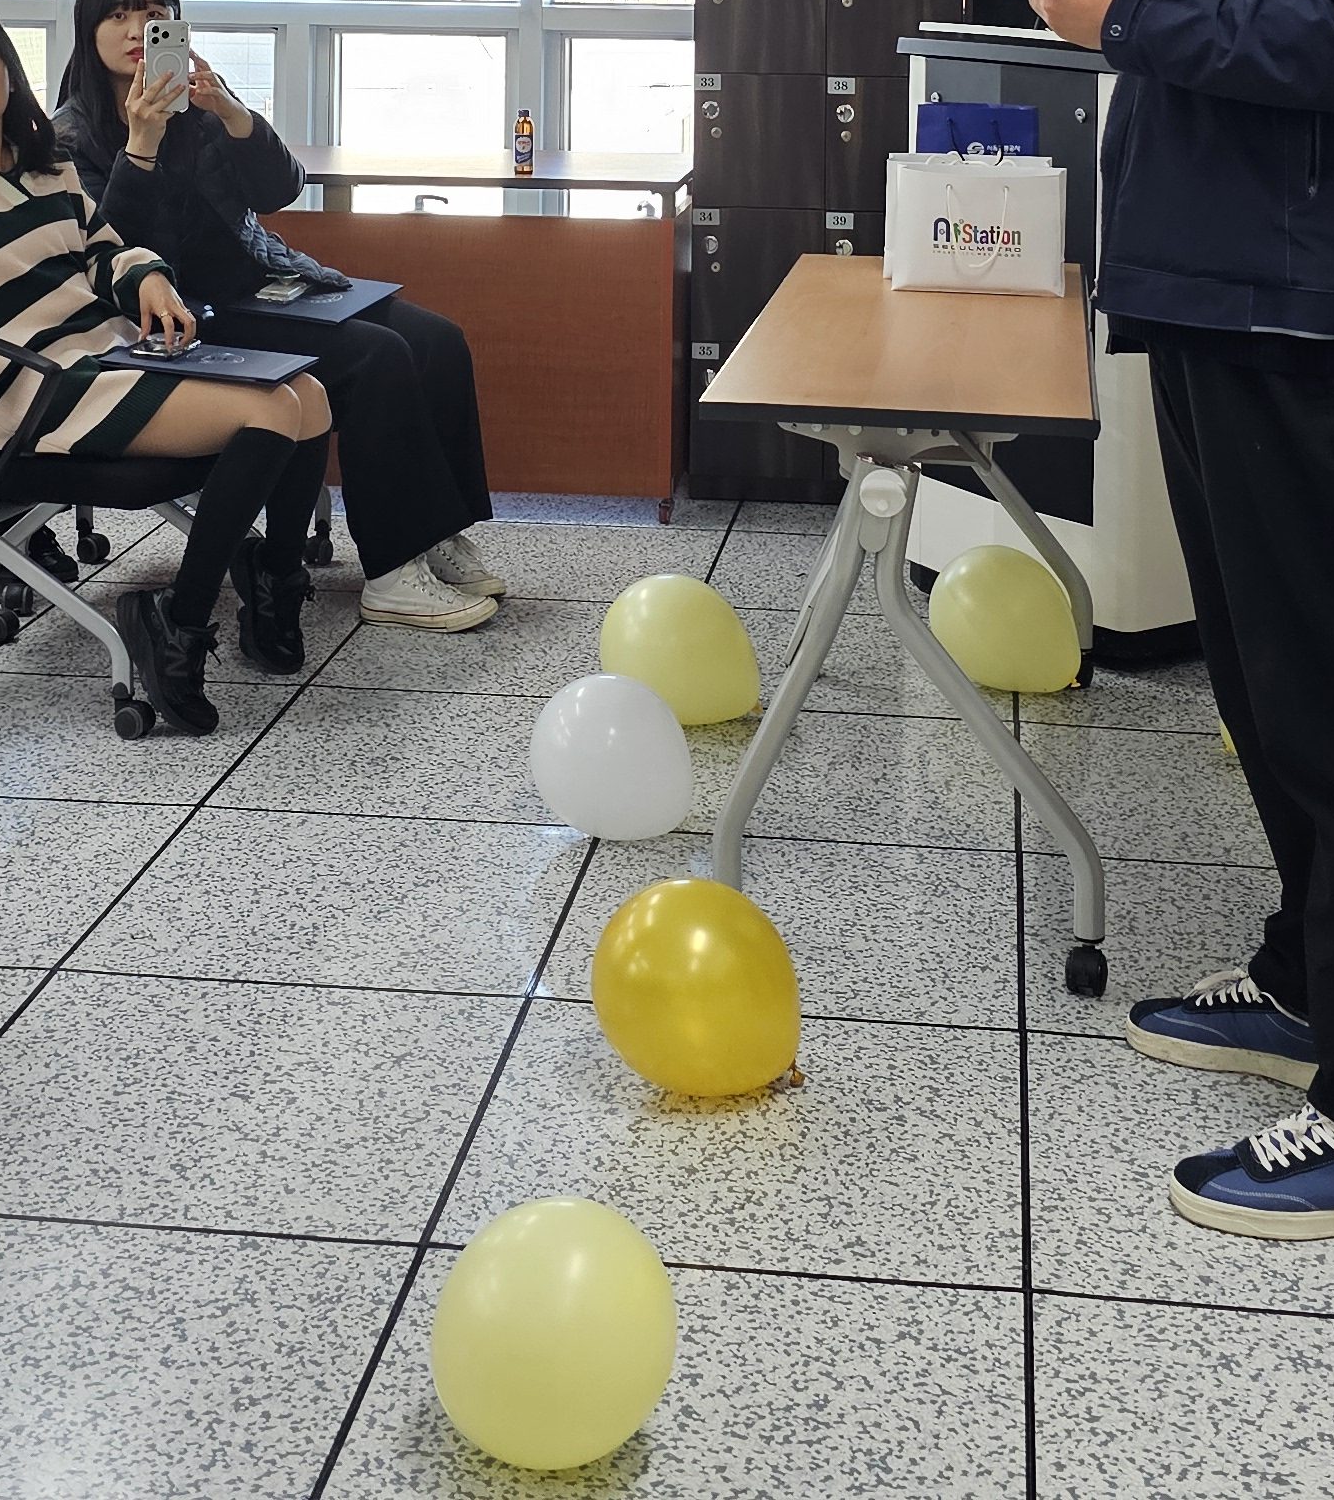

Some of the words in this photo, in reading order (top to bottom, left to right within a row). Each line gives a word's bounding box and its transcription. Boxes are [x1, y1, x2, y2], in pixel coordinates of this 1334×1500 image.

[700, 77, 715, 87] 33
[834, 81, 848, 91] 38
[699, 212, 713, 222] 34
[832, 215, 847, 226] 39
[698, 346, 713, 356] 35
